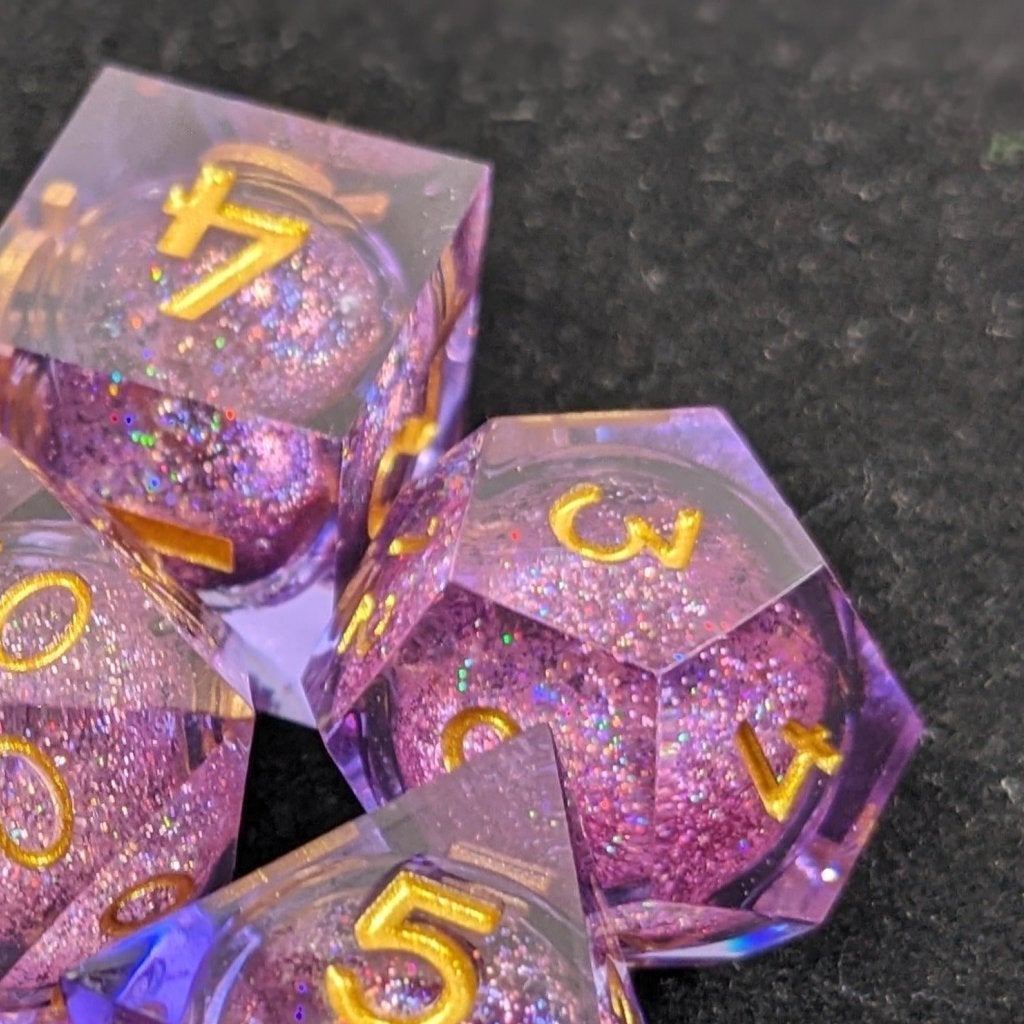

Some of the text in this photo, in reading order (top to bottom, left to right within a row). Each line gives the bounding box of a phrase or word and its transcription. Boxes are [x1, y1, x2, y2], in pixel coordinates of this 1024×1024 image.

[157, 163, 310, 322] 4
[549, 483, 702, 570] 3
[734, 719, 842, 822] 4
